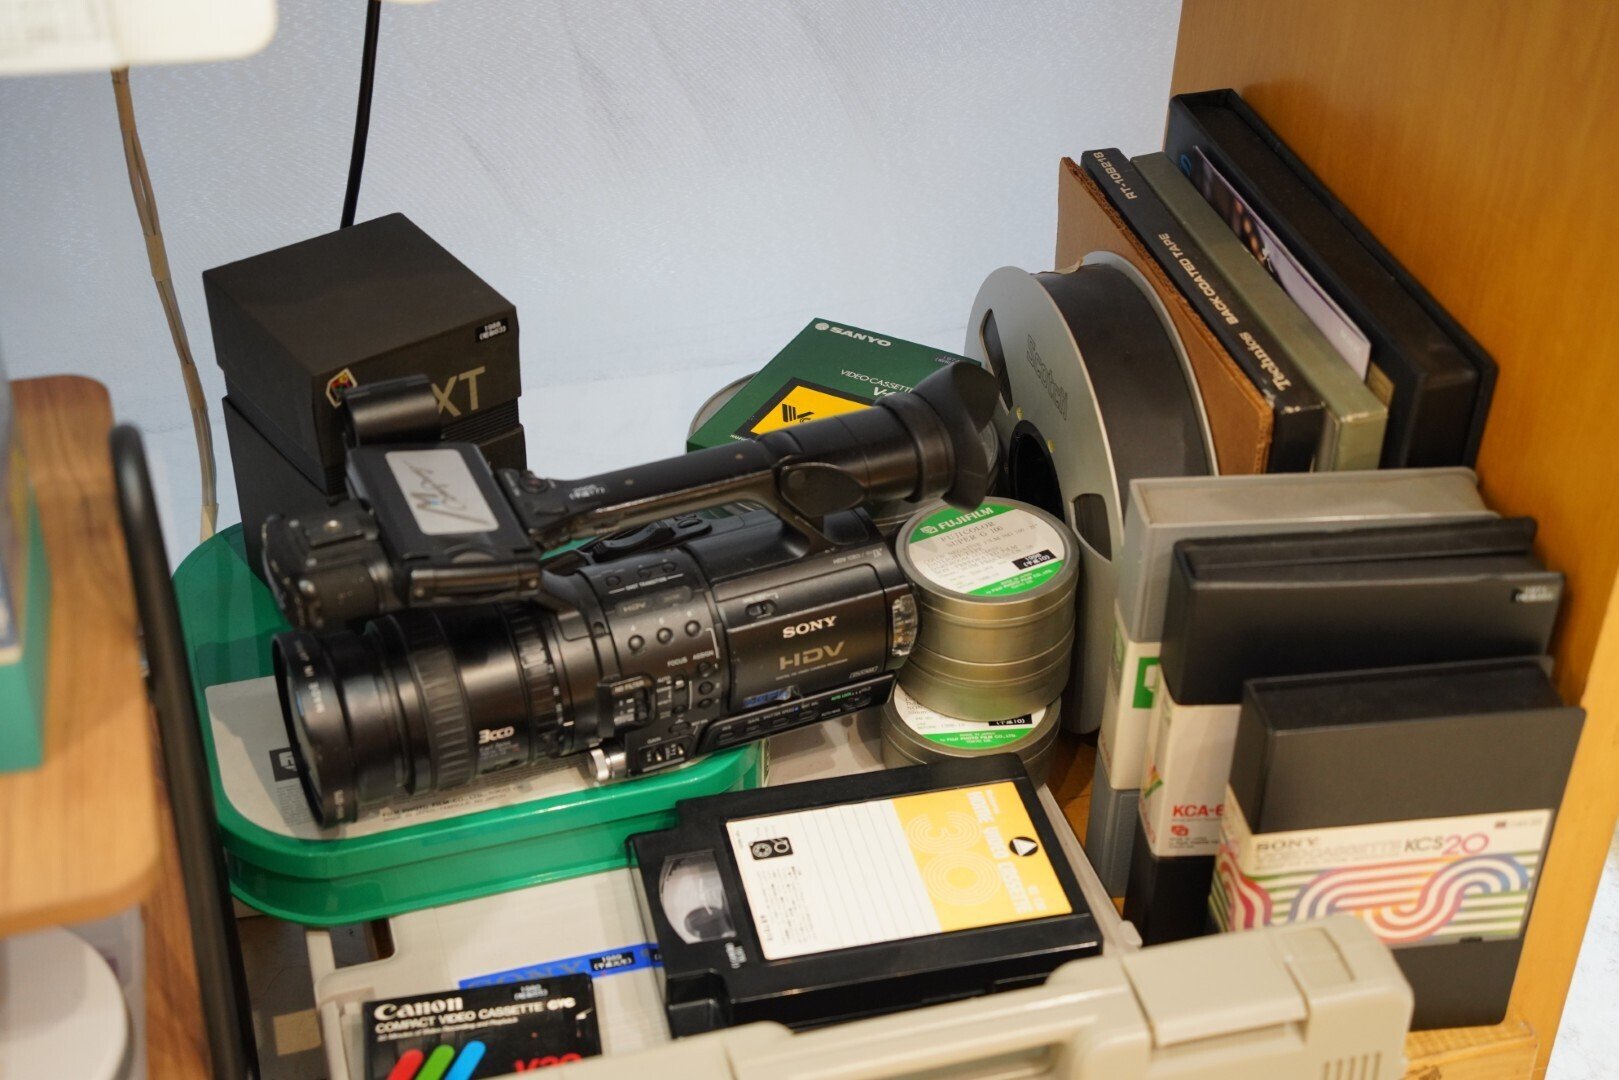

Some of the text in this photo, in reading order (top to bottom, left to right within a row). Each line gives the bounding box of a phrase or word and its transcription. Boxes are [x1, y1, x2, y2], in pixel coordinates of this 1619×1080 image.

[1158, 232, 1184, 262] TAPE
[1179, 258, 1216, 297] COATED
[1208, 292, 1239, 325] BACK
[830, 326, 892, 348] SANYO
[1239, 331, 1292, 391] Technics
[841, 369, 870, 382] VIDEO
[938, 507, 995, 530] FUJIFILM
[782, 616, 838, 639] SONY
[779, 641, 845, 671] HDV
[1256, 836, 1320, 851] SONY
[374, 996, 464, 1021] Canon
[375, 1015, 437, 1034] COMPACT
[437, 1010, 477, 1026] VIDEO
[477, 1000, 546, 1020] CASSETTE
